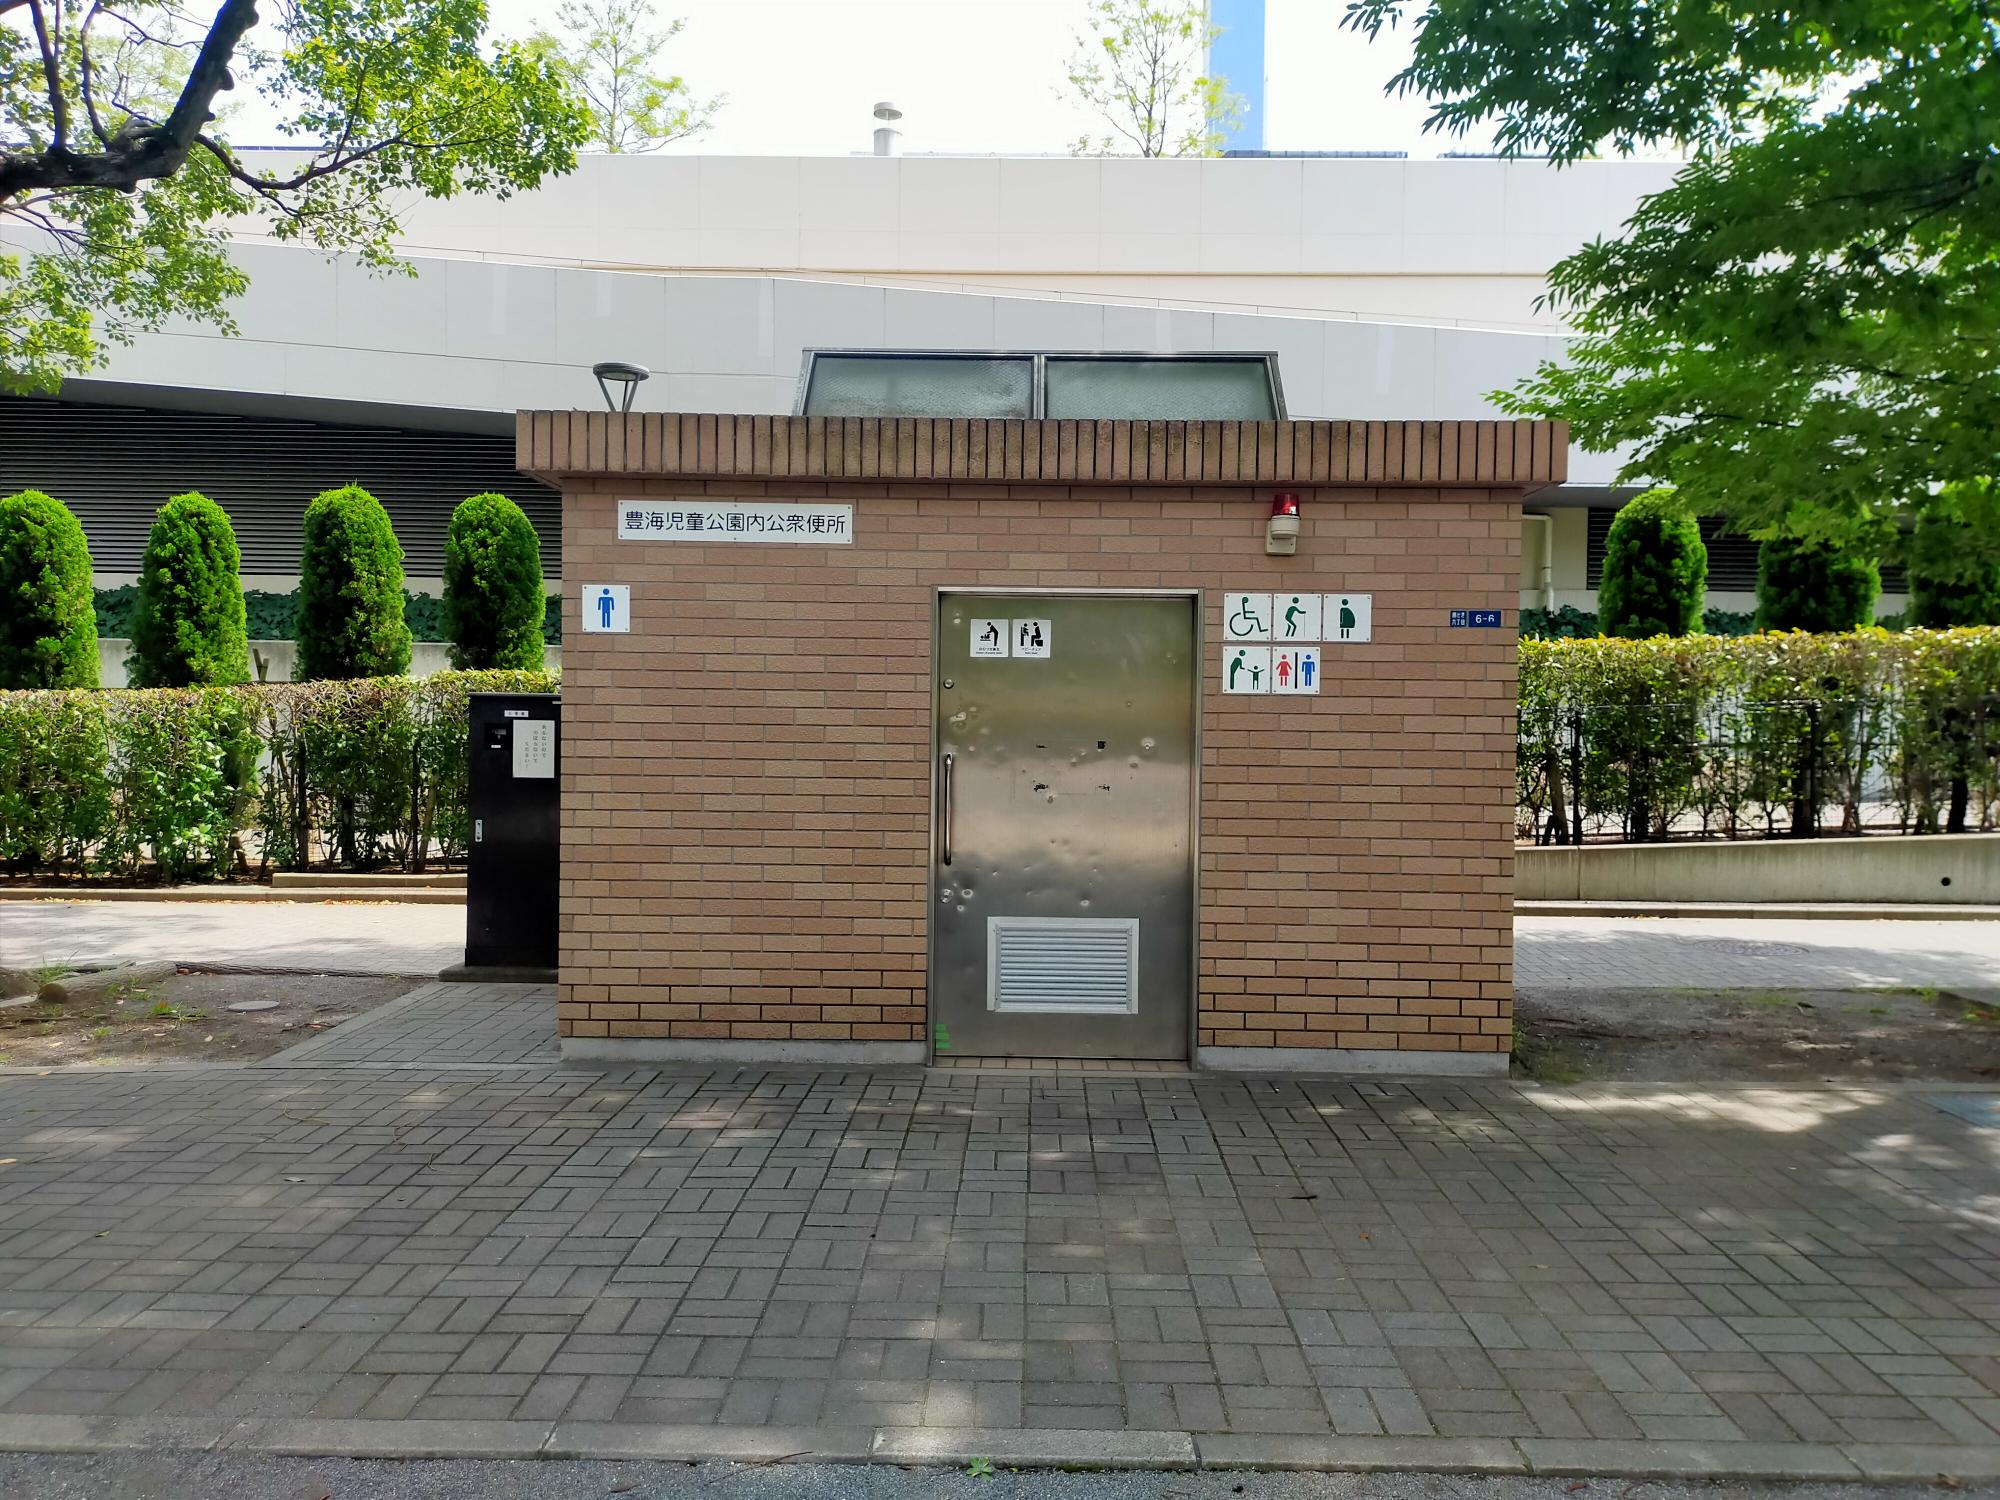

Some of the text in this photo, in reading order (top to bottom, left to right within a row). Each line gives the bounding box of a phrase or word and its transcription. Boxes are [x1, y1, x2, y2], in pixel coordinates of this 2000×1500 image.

[624, 510, 847, 534] 豊海児童公園内公衆便所
[1475, 614, 1495, 624] 6-6
